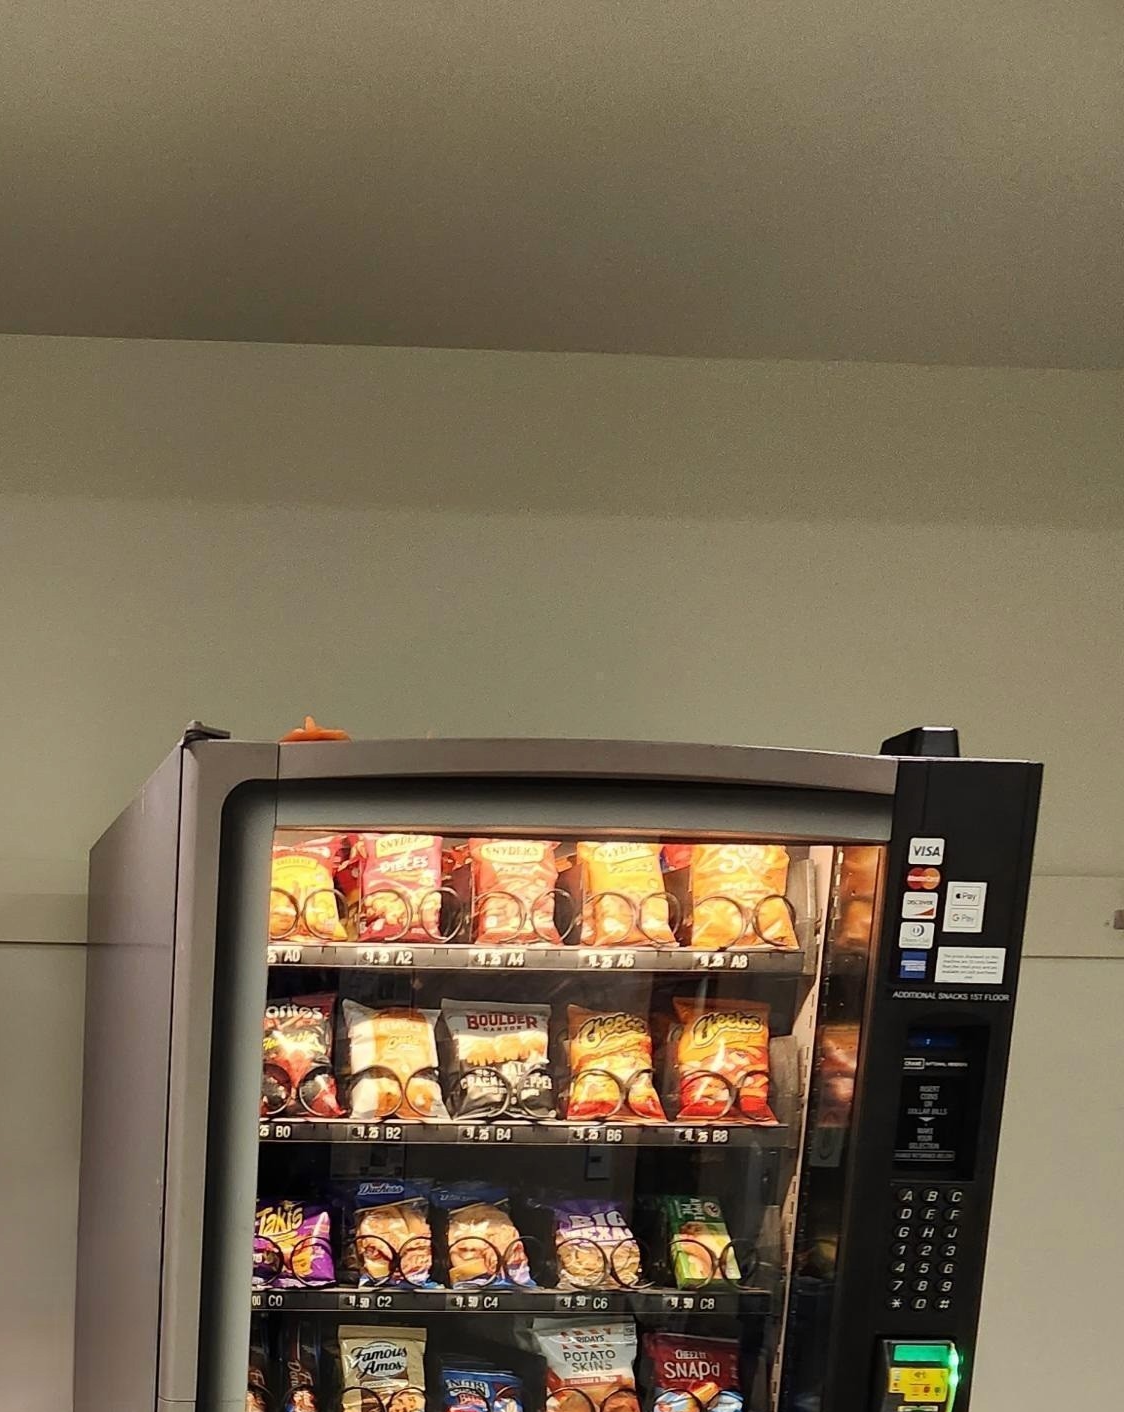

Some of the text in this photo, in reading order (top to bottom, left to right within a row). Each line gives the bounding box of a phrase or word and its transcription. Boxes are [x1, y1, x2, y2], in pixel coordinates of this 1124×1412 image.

[913, 845, 941, 857] VISA
[962, 892, 977, 901] Pay
[961, 914, 975, 923] Pay
[284, 952, 301, 962] A0
[396, 952, 413, 964] A2
[507, 953, 524, 966] A4
[617, 954, 634, 968] A6
[730, 955, 748, 968] A8
[892, 991, 936, 999] ADDITIONAL
[938, 992, 969, 1000] SNACKS
[970, 993, 984, 1001] 1ST
[266, 1004, 322, 1020] oritos
[466, 1013, 538, 1029] BOULDER
[693, 1012, 764, 1046] Cheetos
[276, 1126, 291, 1138] B0
[385, 1127, 401, 1139] B2
[496, 1128, 511, 1140] B4
[606, 1129, 622, 1142] B6
[903, 1191, 962, 1202] A B C
[257, 1205, 304, 1235] Takis
[569, 1210, 626, 1228] BIG
[900, 1209, 960, 1220] D E F
[898, 1227, 957, 1238] G H J
[900, 1245, 956, 1256] 1 2 3
[895, 1263, 953, 1274] 4 5 6
[893, 1281, 952, 1292] 7 8 9
[377, 1295, 392, 1307] C2
[484, 1296, 499, 1308] C4
[593, 1297, 608, 1309] C6
[700, 1298, 715, 1310] C8
[916, 1299, 927, 1308] 0
[351, 1346, 408, 1369] Famous
[563, 1350, 616, 1362] POTATO
[356, 1361, 403, 1379] Amos
[571, 1360, 613, 1373] SKINS
